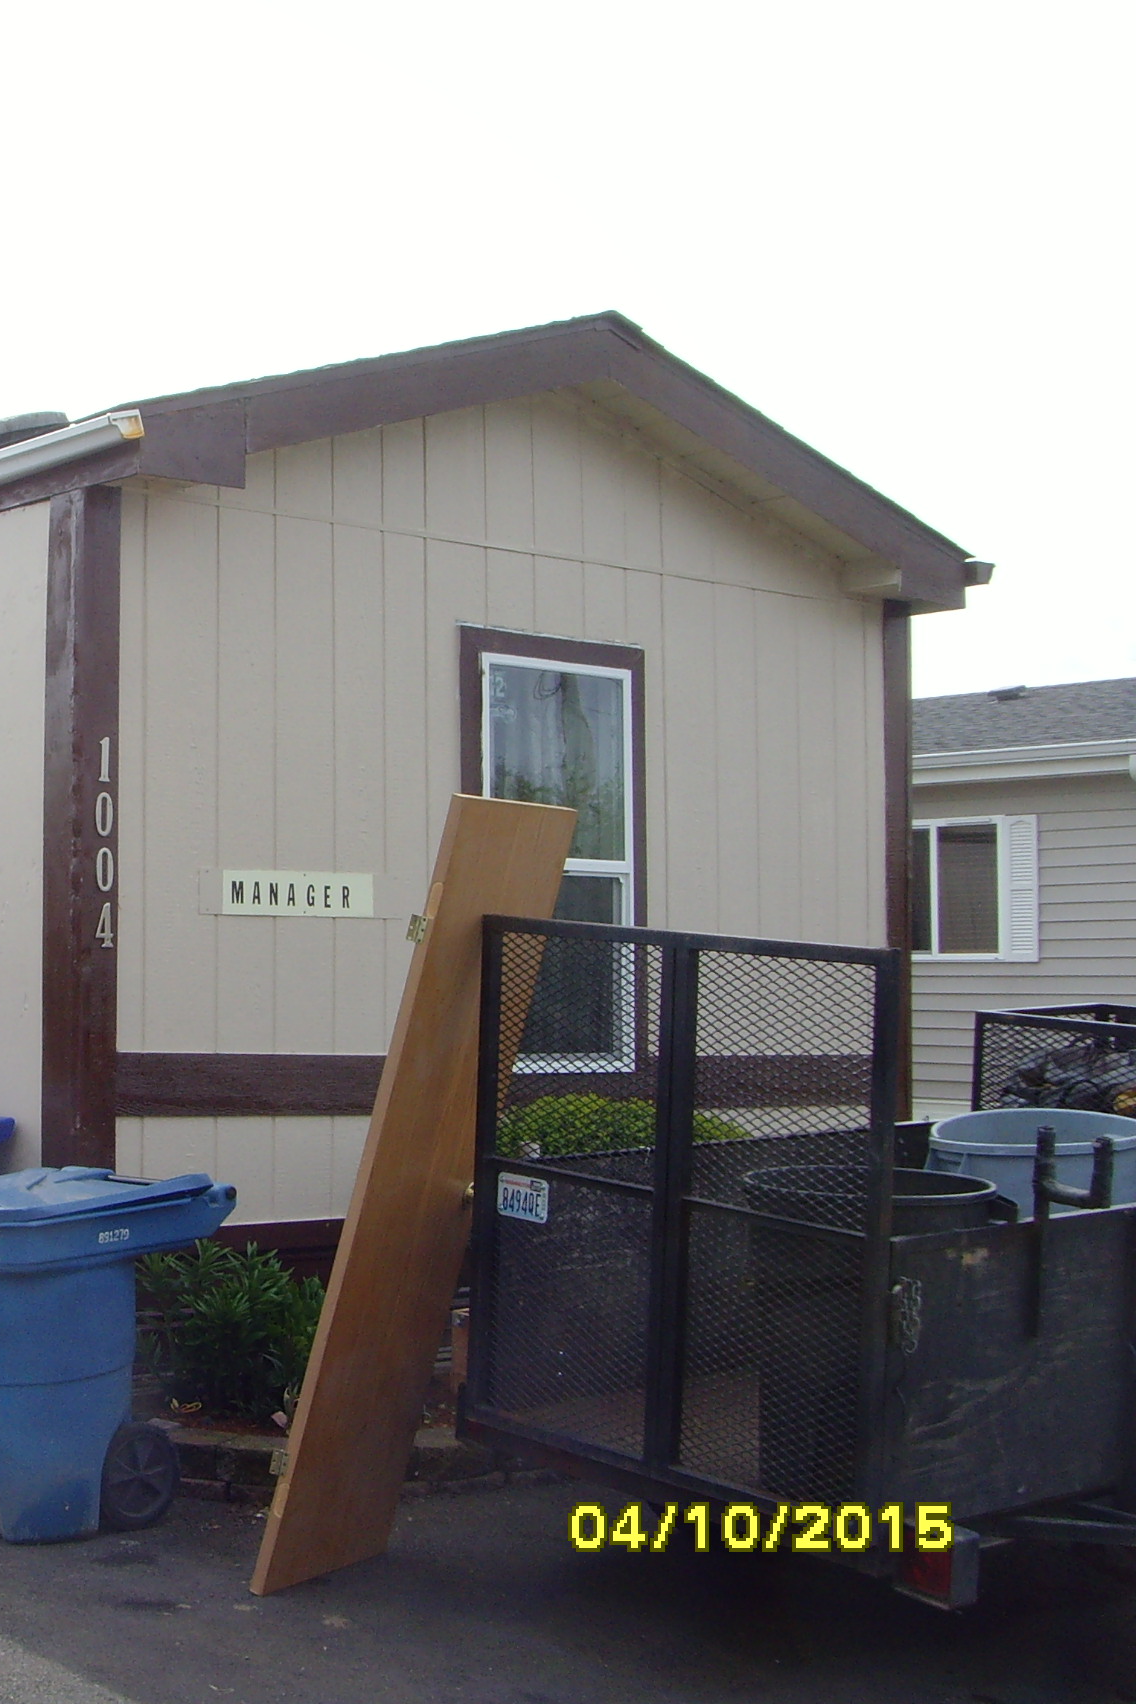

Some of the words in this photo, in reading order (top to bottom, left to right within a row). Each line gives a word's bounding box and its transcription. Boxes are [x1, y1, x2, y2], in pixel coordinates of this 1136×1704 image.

[95, 737, 115, 949] 1004
[231, 880, 351, 910] MANAGER
[502, 1187, 541, 1217] 8494QE
